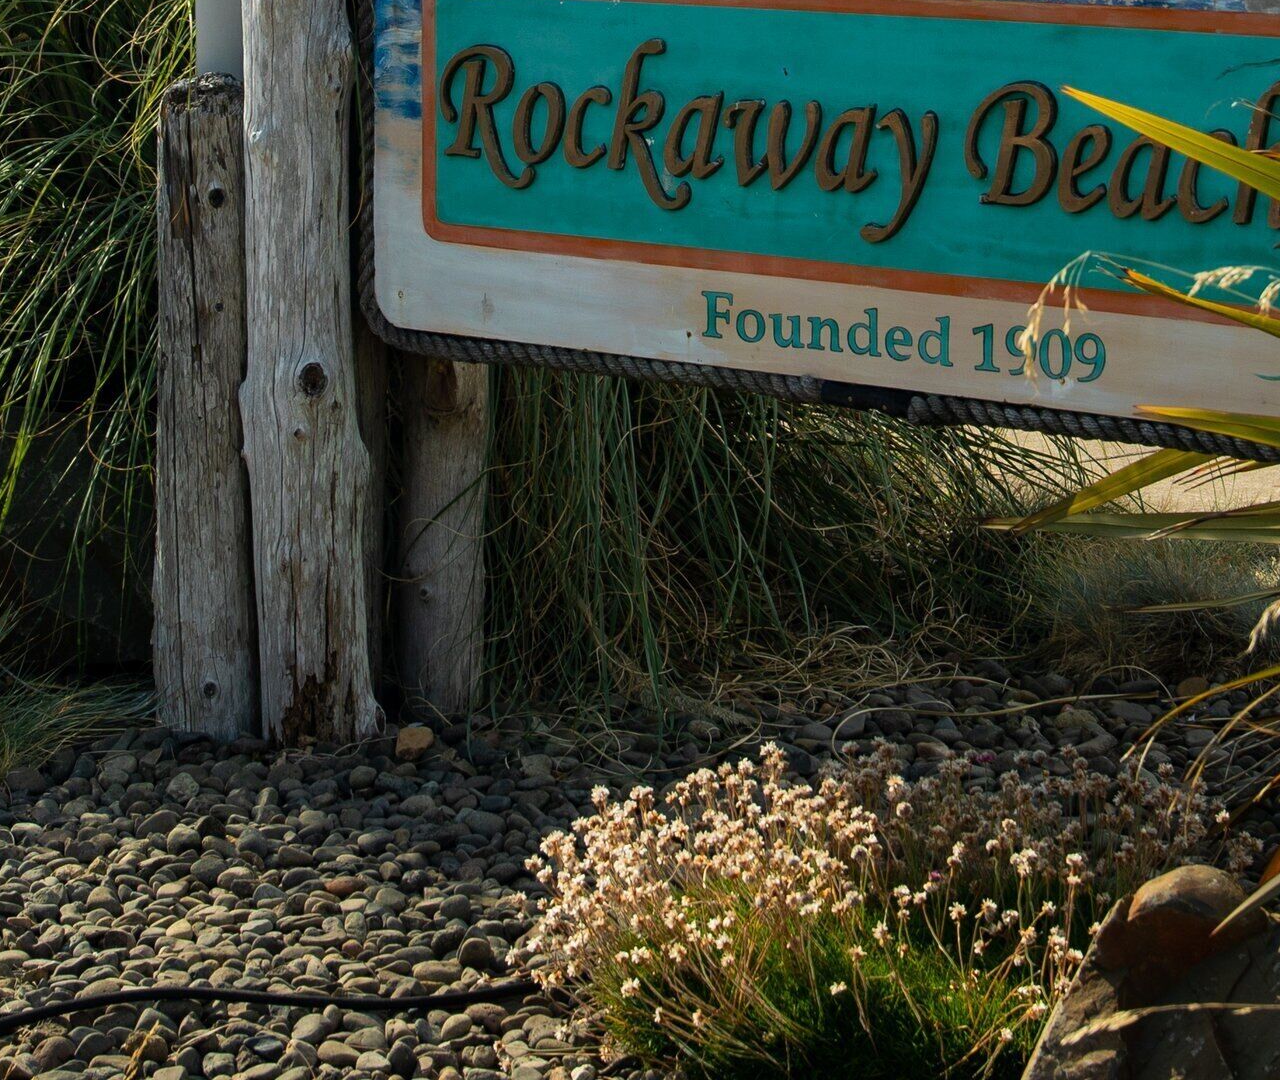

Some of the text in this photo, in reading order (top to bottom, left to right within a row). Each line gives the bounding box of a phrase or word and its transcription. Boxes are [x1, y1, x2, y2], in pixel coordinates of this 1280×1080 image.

[440, 38, 938, 242] Rockaway
[701, 290, 1107, 383] Founded 1909
